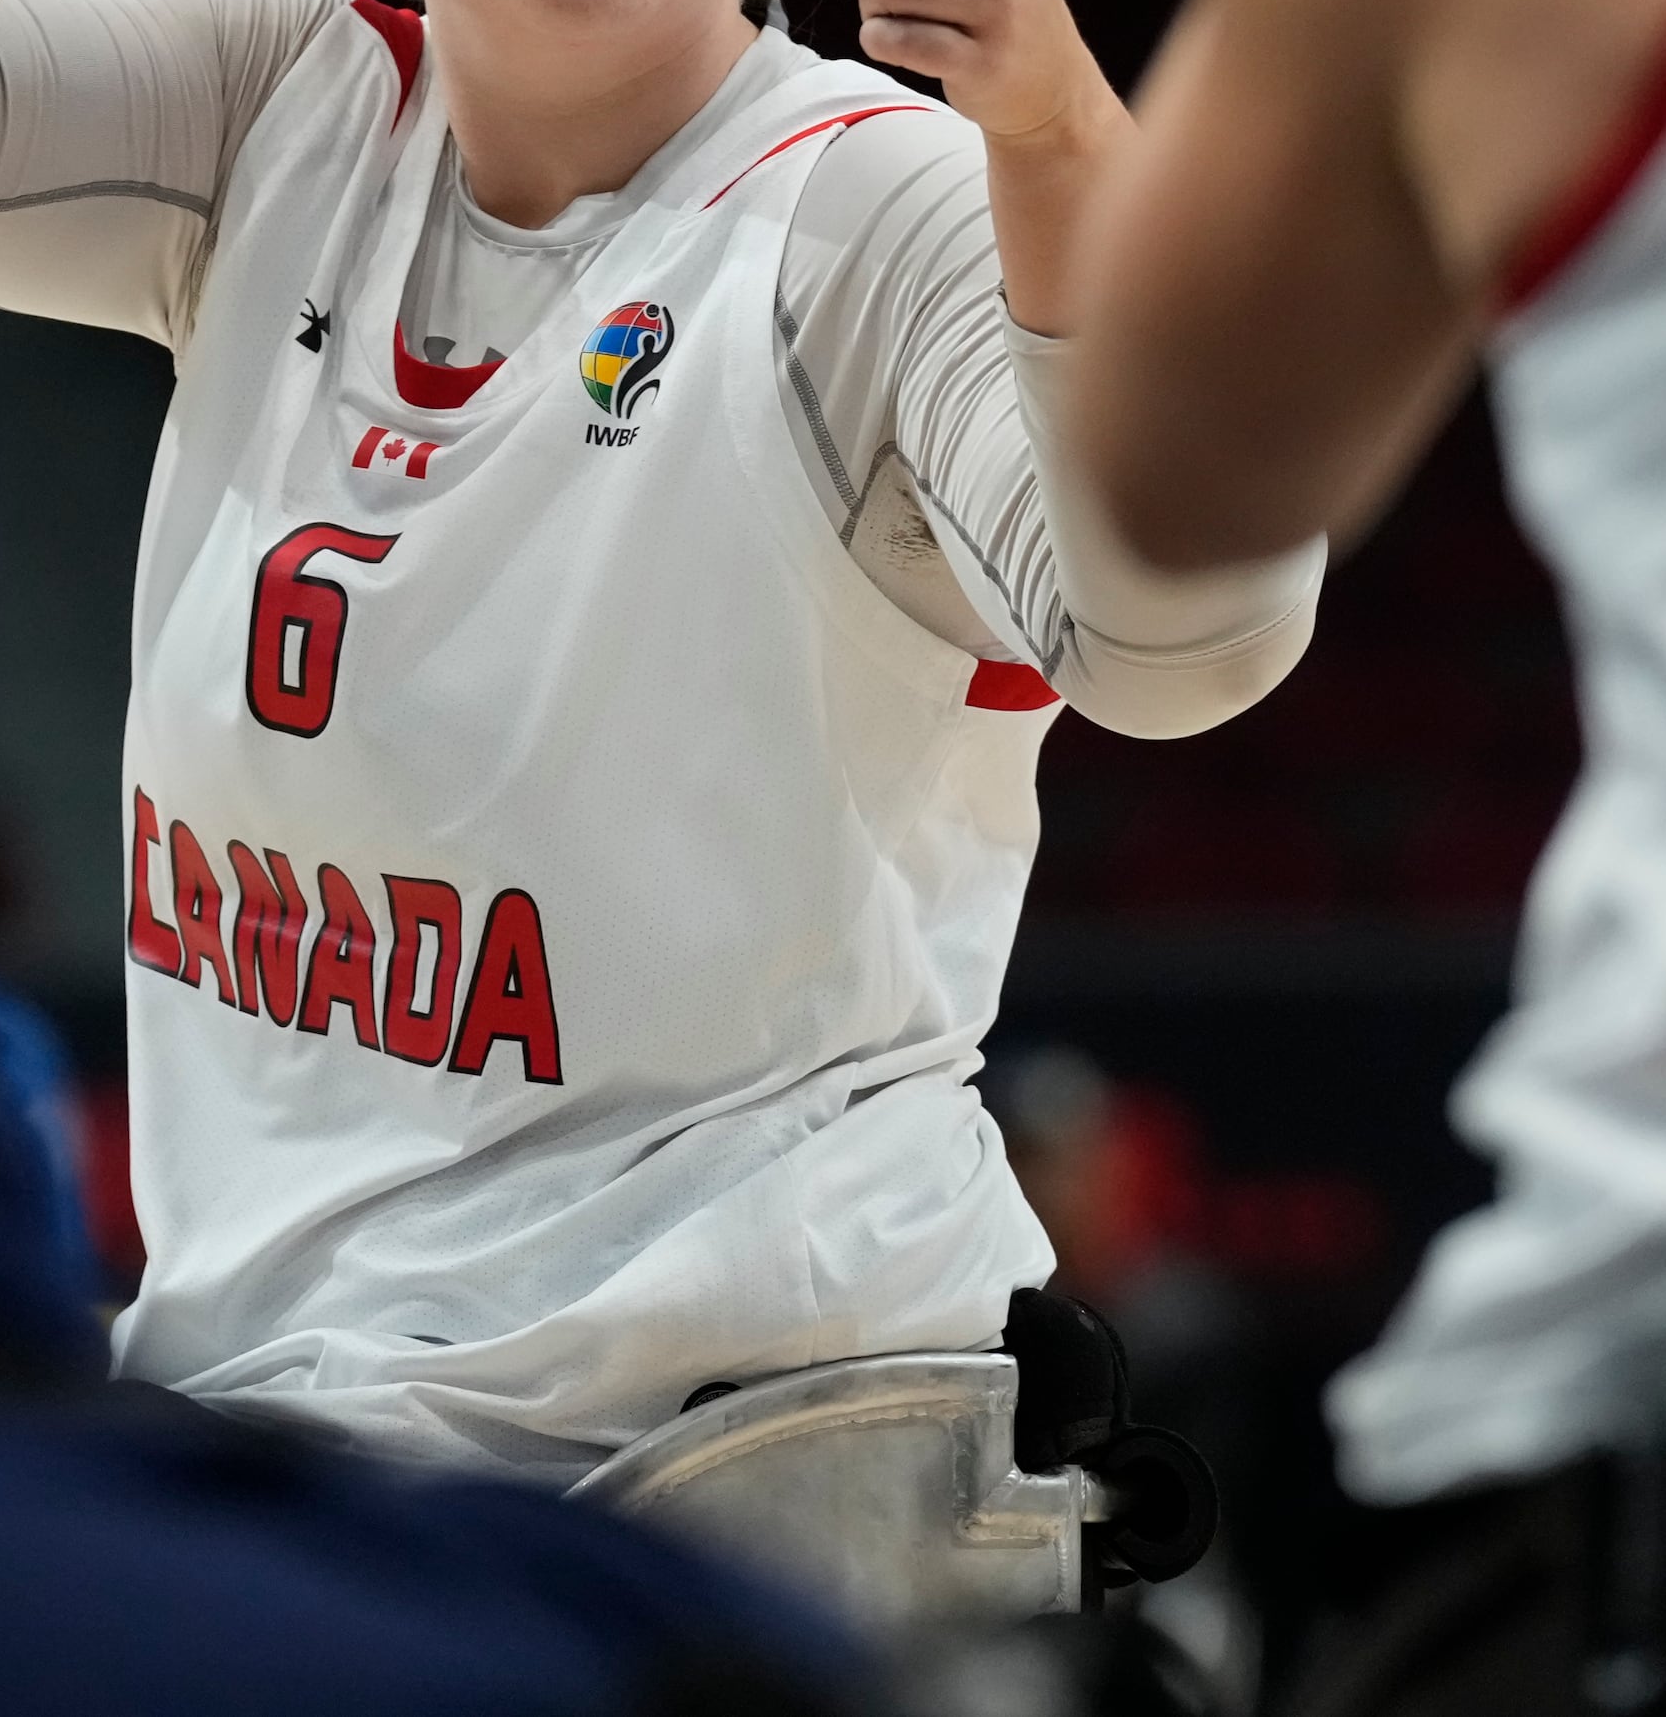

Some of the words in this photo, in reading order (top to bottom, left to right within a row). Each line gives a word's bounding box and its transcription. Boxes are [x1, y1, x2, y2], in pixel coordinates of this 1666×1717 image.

[585, 423, 640, 447] IWBF
[245, 521, 403, 739] 6
[128, 783, 564, 1086] CANADA
